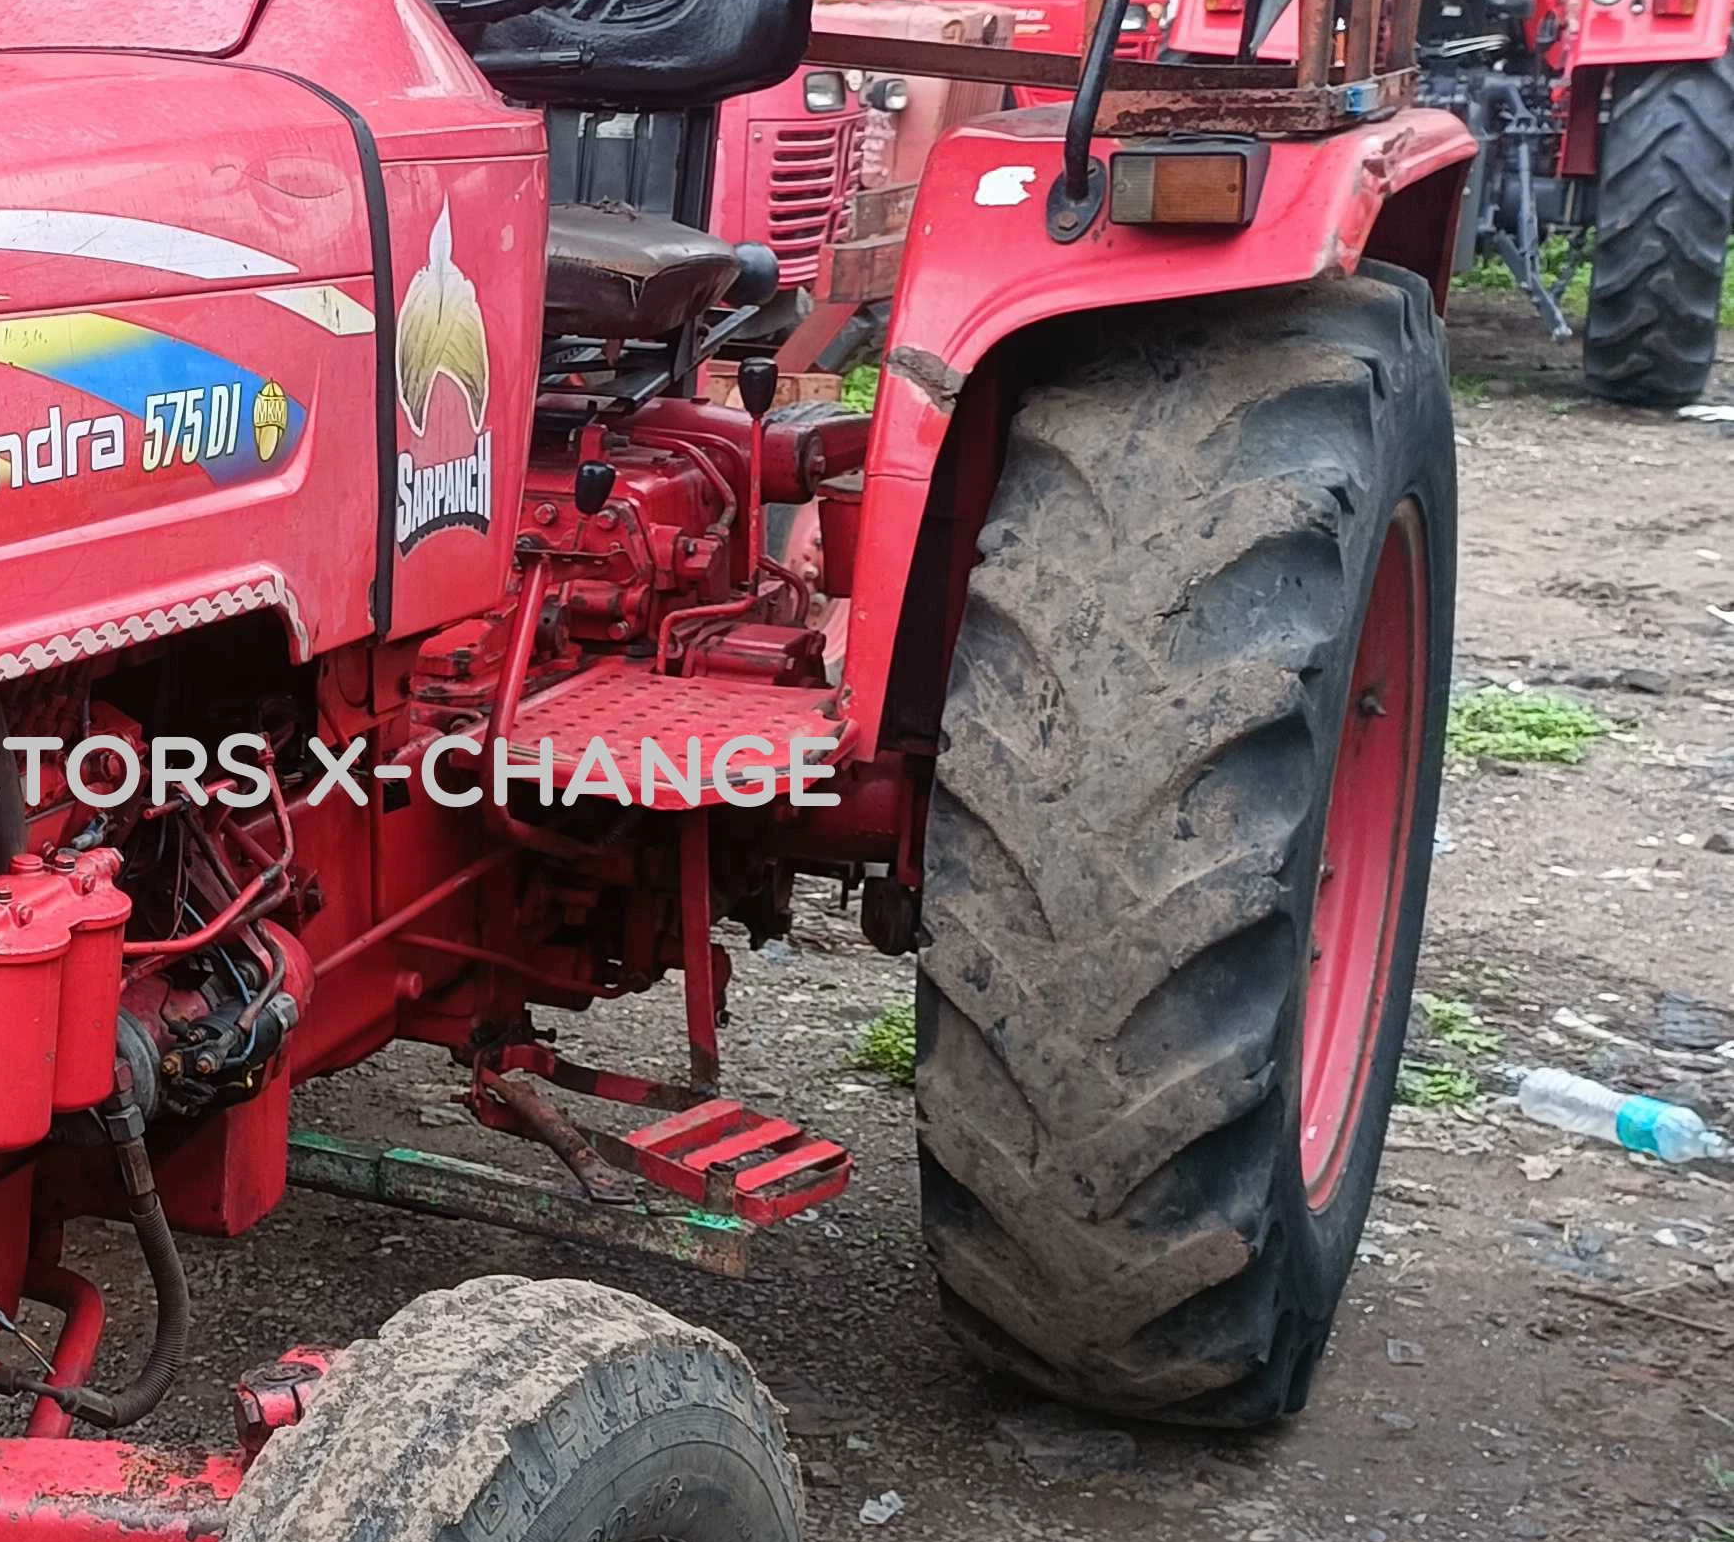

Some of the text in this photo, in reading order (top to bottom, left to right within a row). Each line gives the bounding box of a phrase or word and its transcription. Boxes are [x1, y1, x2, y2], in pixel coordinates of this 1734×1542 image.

[142, 388, 205, 472] 575
[205, 382, 242, 459] DI
[396, 430, 492, 544] SARPANCH
